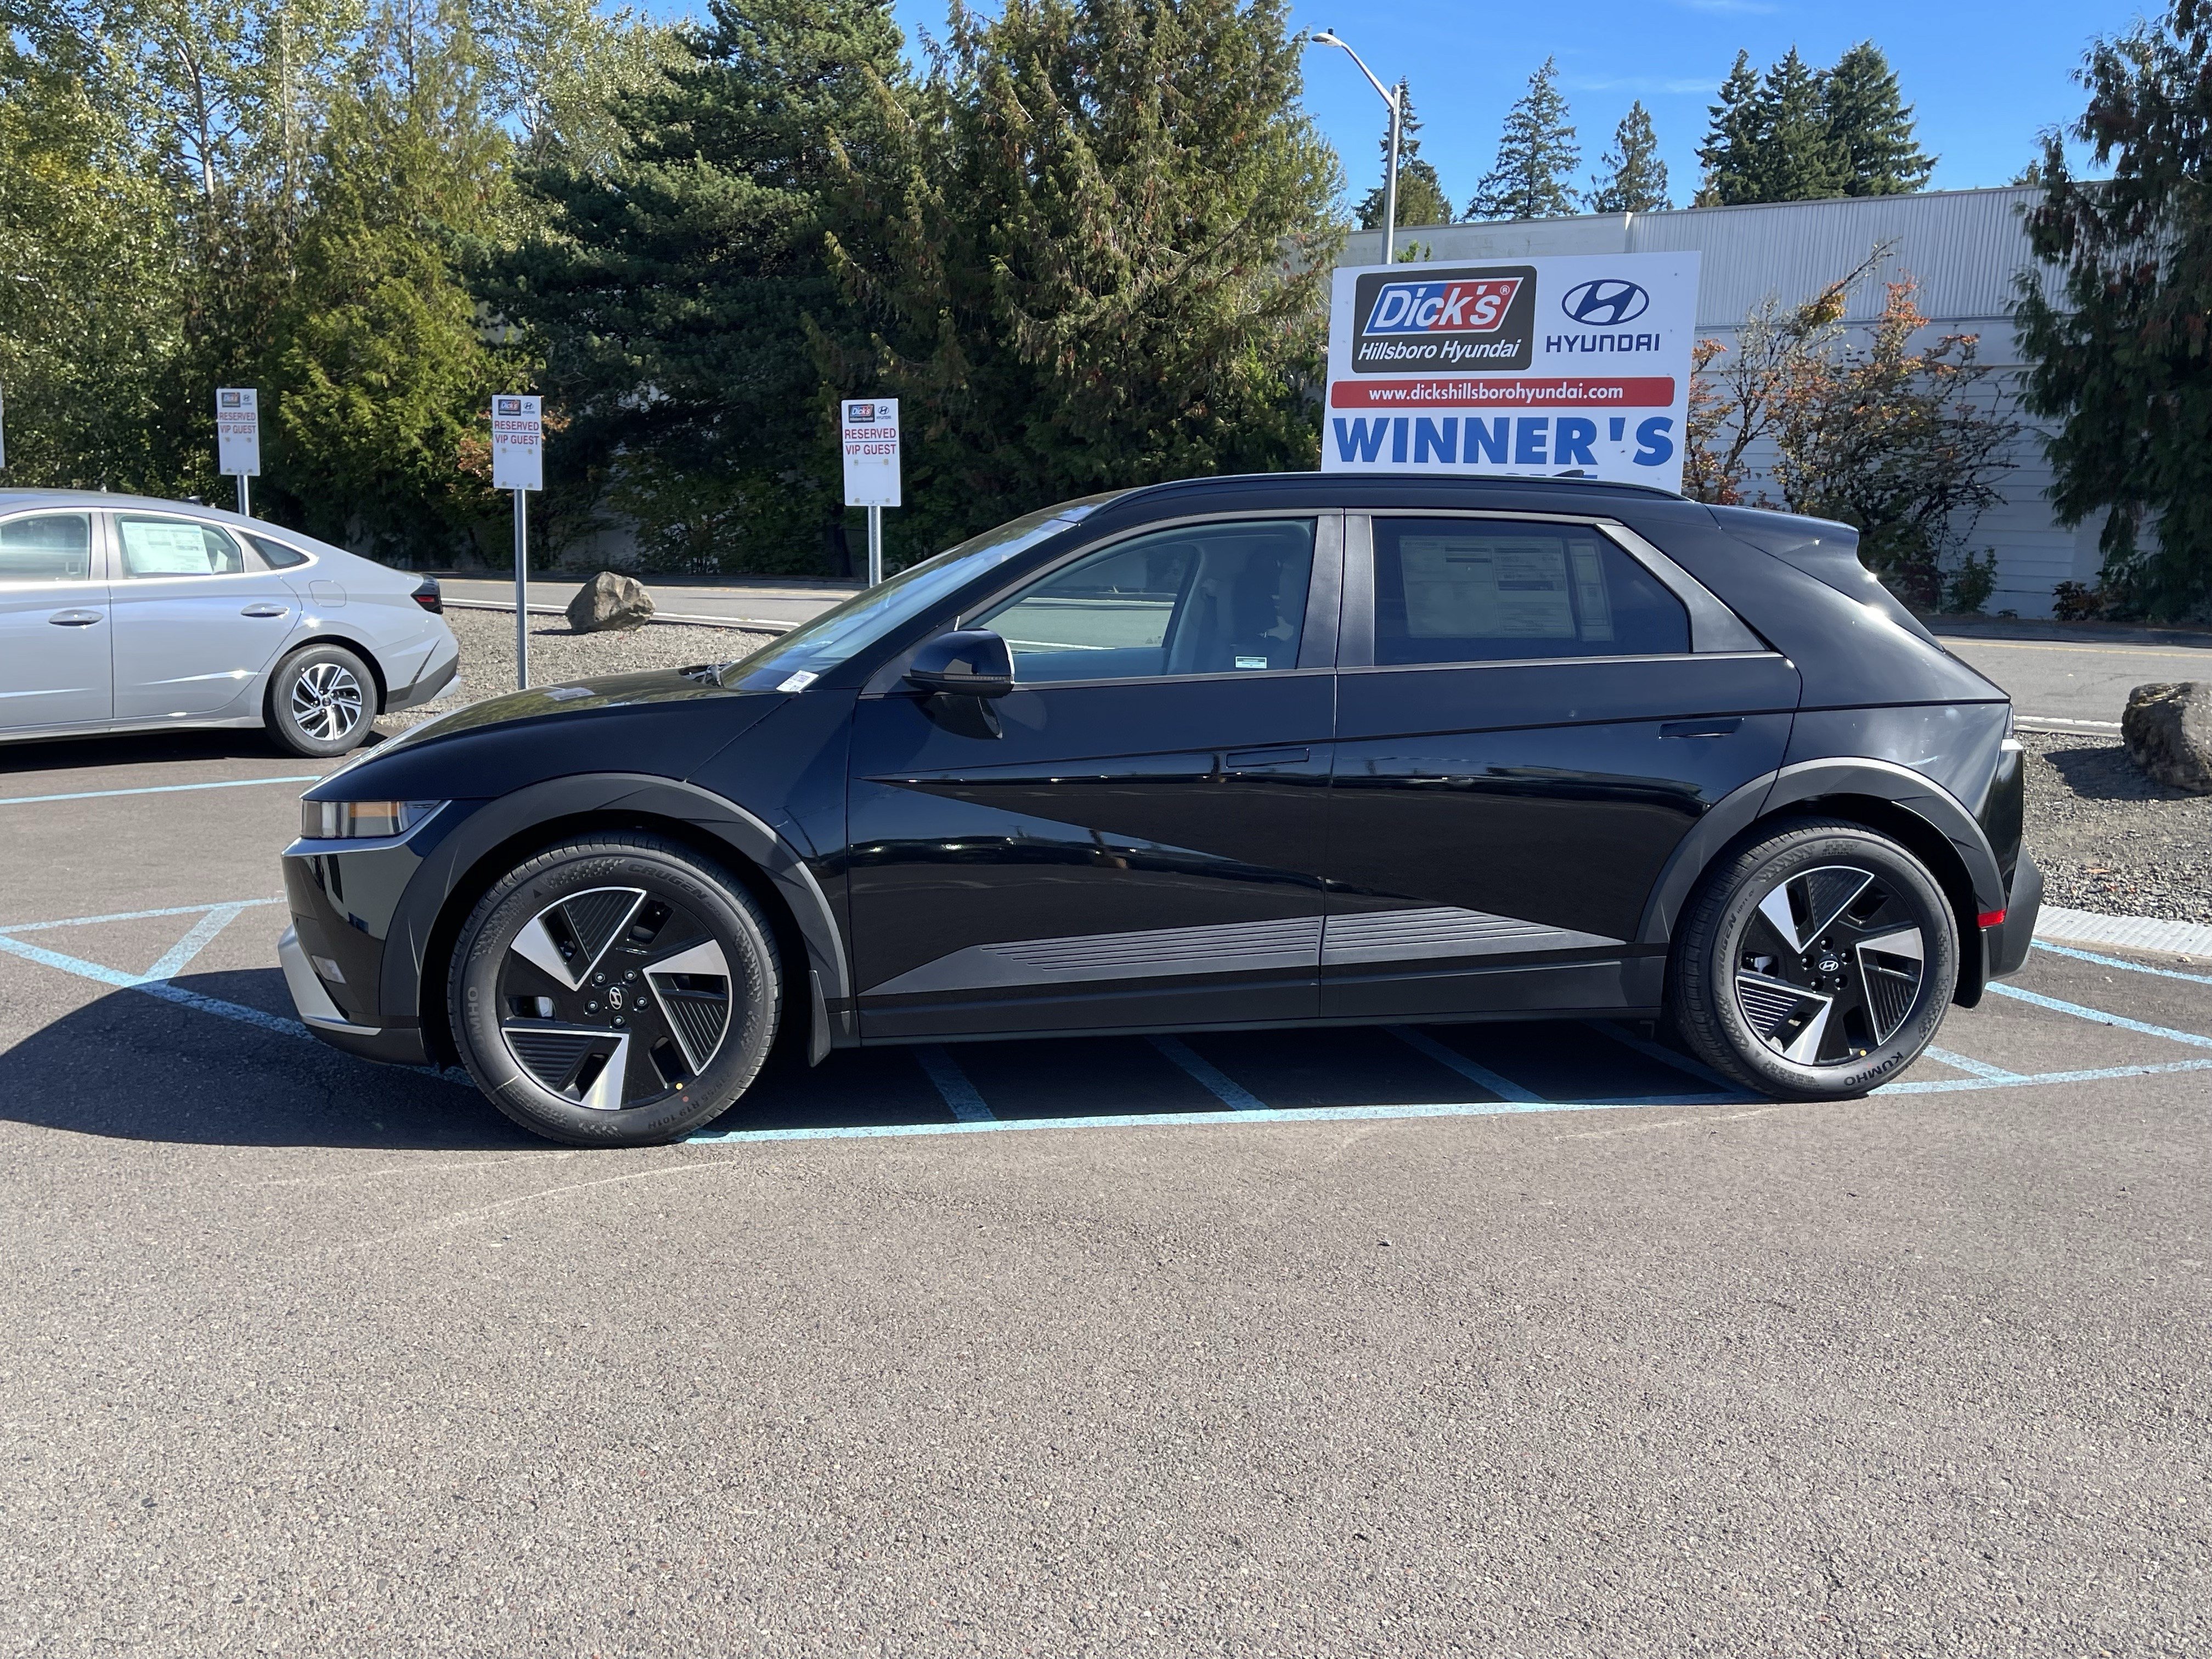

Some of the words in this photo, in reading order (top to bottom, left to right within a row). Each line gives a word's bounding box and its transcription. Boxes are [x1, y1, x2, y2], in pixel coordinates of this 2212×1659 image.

[1358, 341, 1438, 360] Hillsboro
[1439, 339, 1522, 363] Hyundai
[1545, 334, 1660, 353] HYUNDAI
[1368, 382, 1624, 404] www.dickshillsborohyundai.com
[219, 412, 256, 421] RESERVED
[494, 420, 539, 431] RESERVED
[220, 425, 231, 433] VIP
[233, 425, 256, 434] GUEST
[844, 428, 896, 439] RESERVED
[495, 434, 508, 444] VIP
[511, 435, 539, 445] GUEST
[1333, 416, 1674, 466] WINNER'S
[845, 444, 861, 455] VIP
[864, 444, 896, 455] GUEST
[628, 864, 709, 901] CRUGEN
[1718, 912, 1737, 986] CRUGEN
[1844, 1051, 1904, 1086] KUMHO
